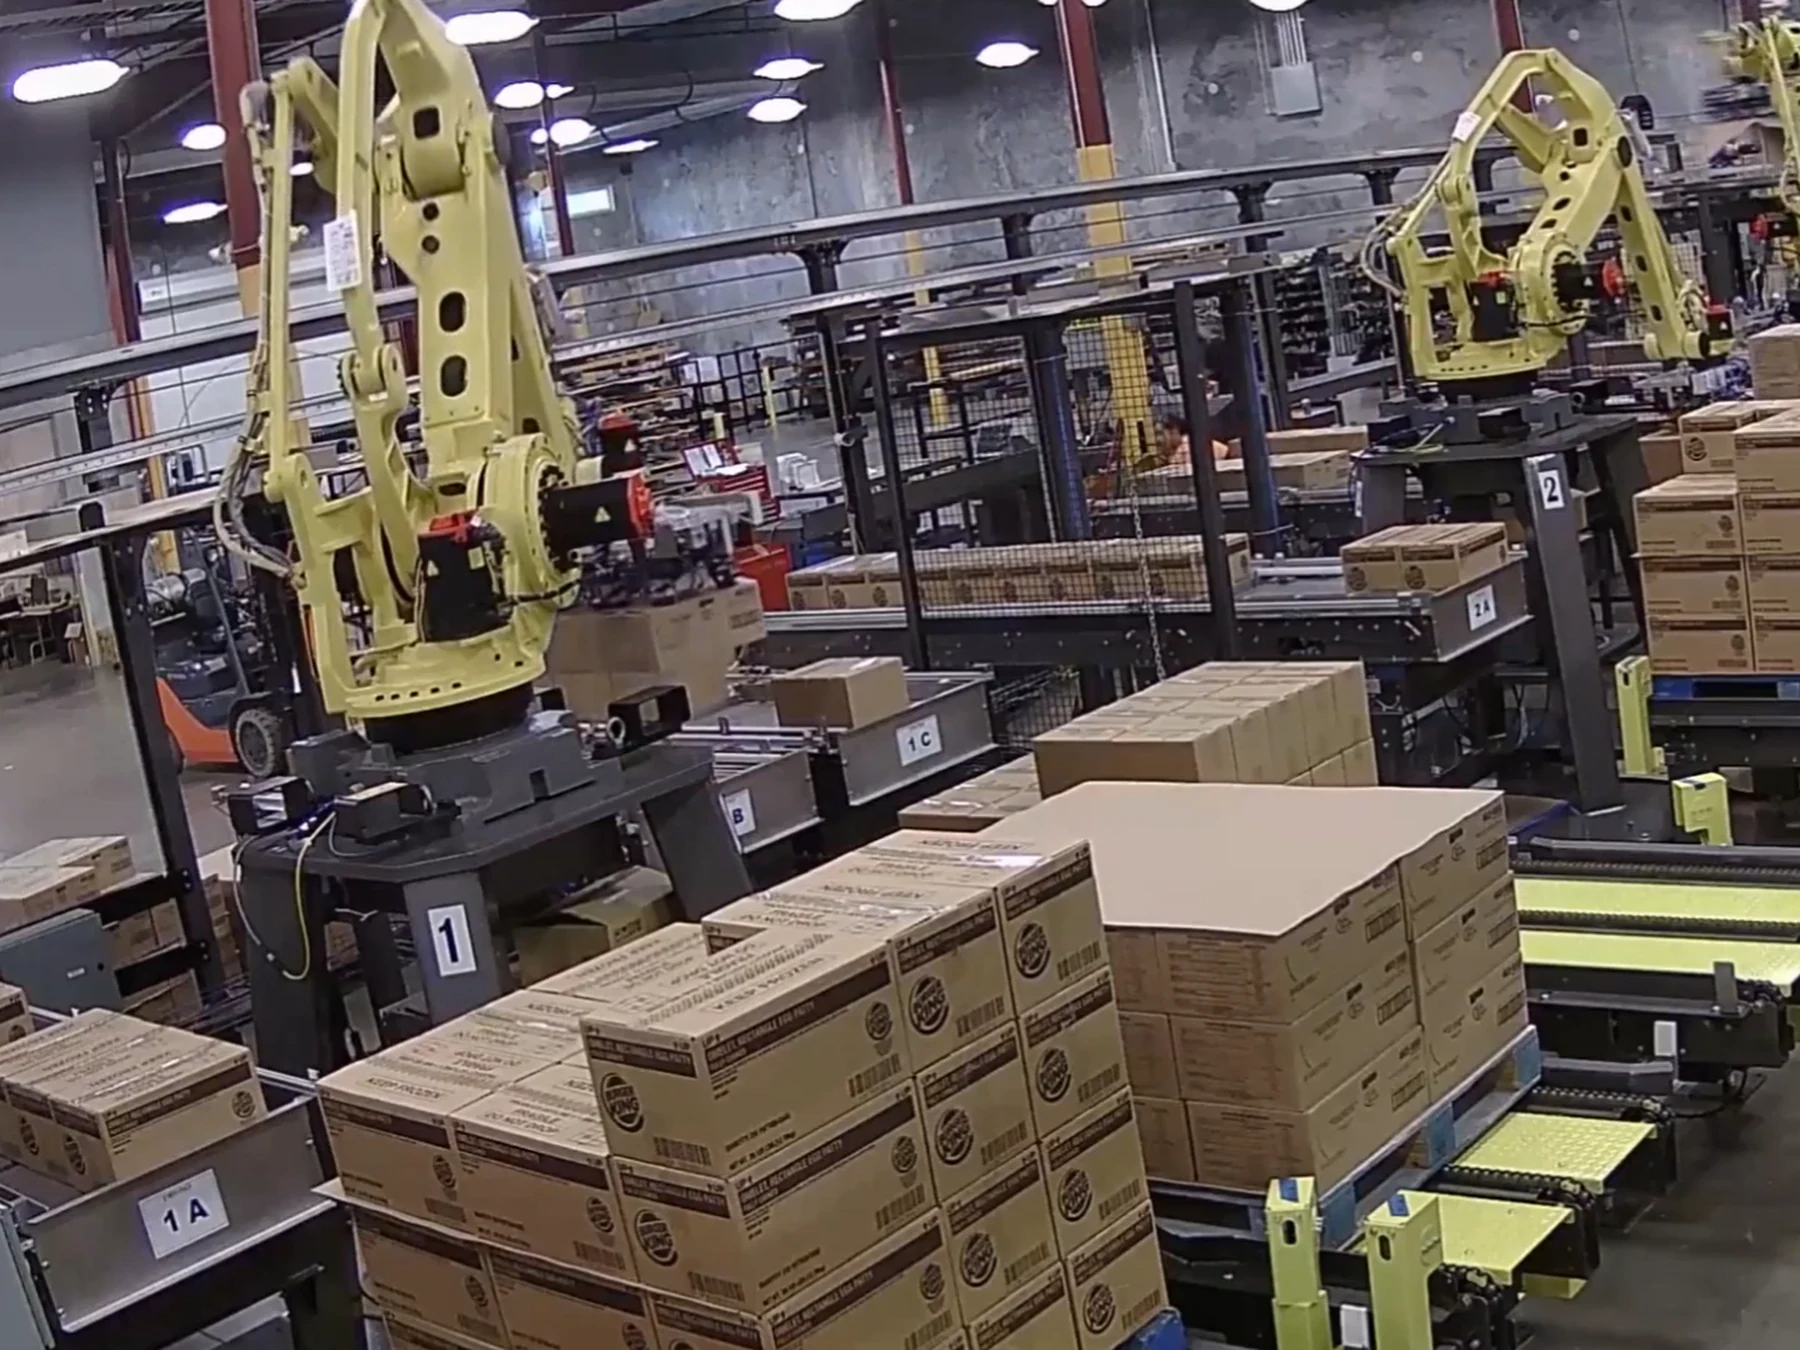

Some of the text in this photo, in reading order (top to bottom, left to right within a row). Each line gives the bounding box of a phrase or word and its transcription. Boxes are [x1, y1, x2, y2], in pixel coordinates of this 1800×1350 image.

[1544, 477, 1558, 502] 2
[908, 731, 932, 751] 1 C
[732, 808, 744, 824] B
[439, 917, 459, 963] 1
[164, 1198, 209, 1232] 1 A
